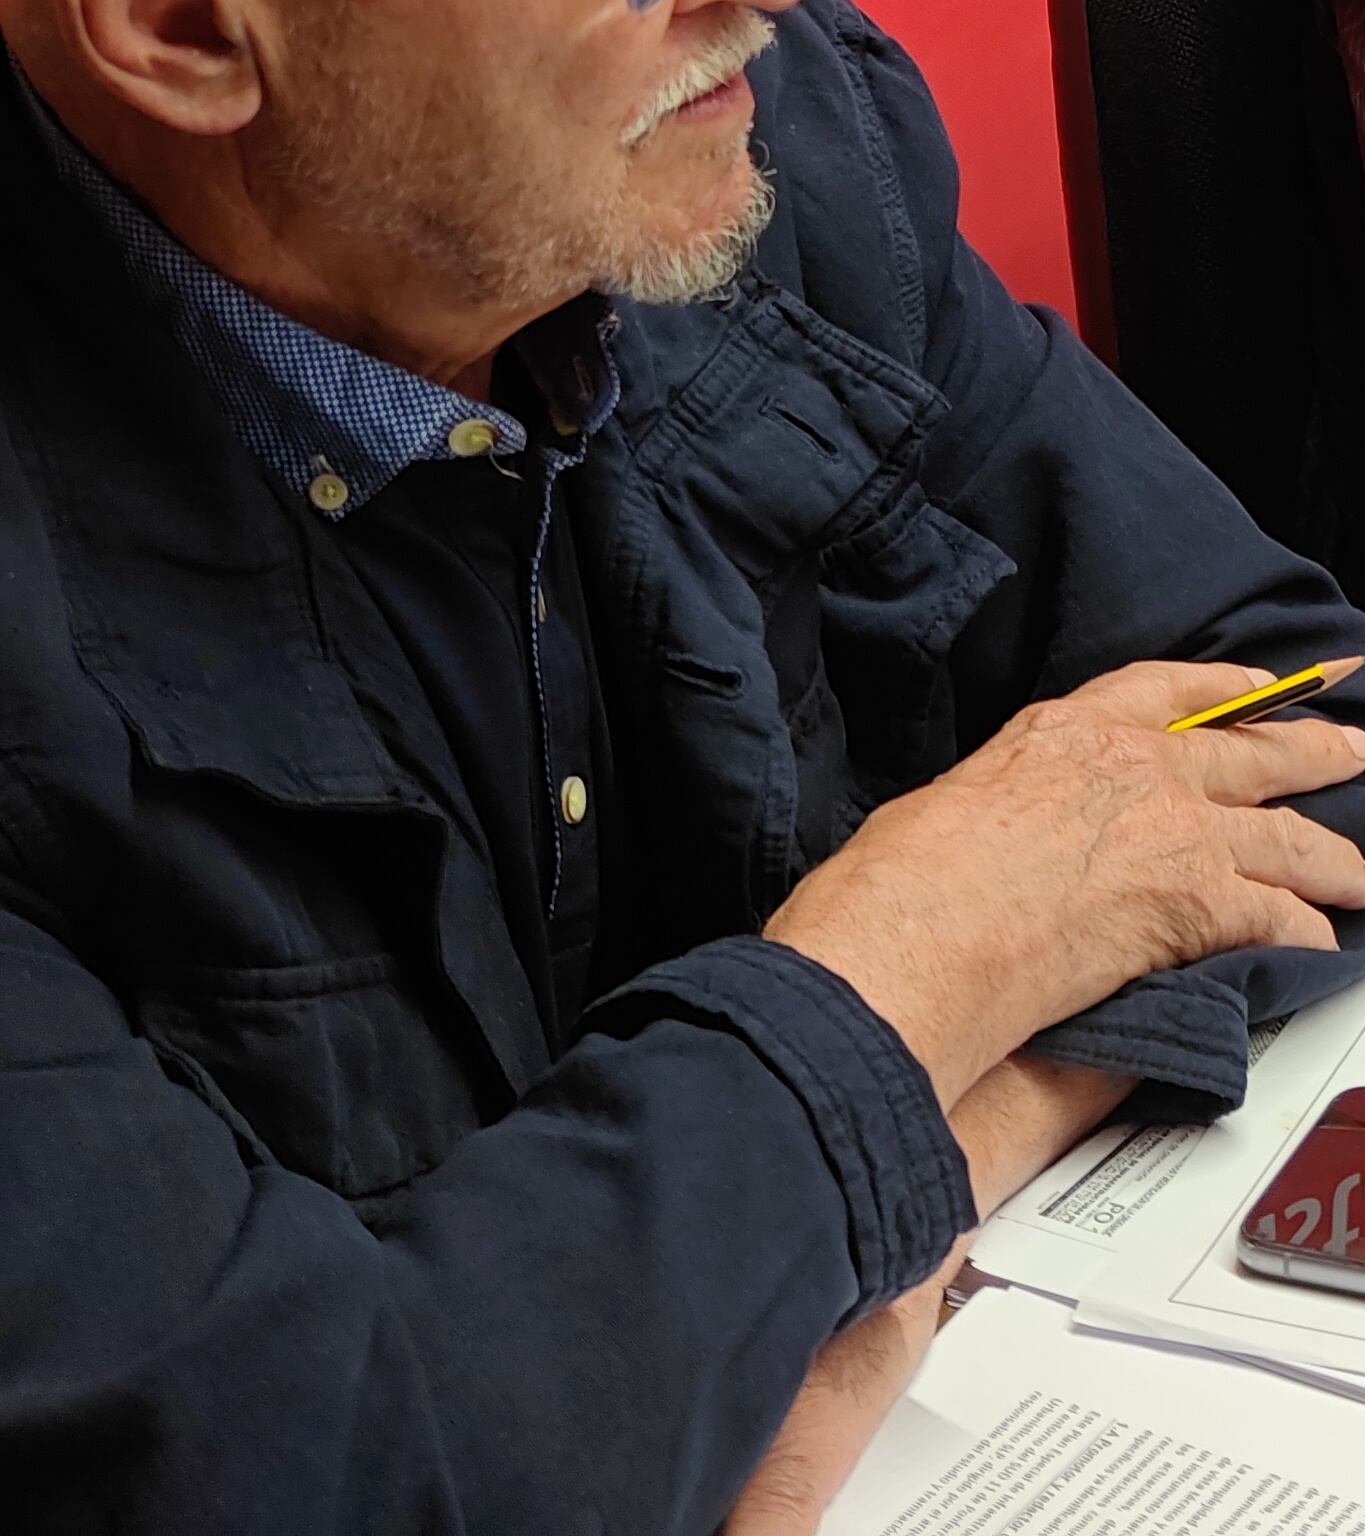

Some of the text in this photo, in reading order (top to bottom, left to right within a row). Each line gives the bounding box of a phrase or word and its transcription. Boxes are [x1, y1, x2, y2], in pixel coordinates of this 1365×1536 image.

[988, 1391, 1042, 1439] responsable
[1032, 1414, 1070, 1446] entorno
[1076, 1411, 1101, 1429] Este
[972, 1440, 991, 1454] del
[1056, 1429, 1082, 1448] Plan
[939, 1453, 975, 1484] estudio
[1017, 1447, 1035, 1462] del
[1022, 1449, 1062, 1483] Especial
[1056, 1438, 1112, 1482] Promotor
[1216, 1457, 1232, 1469] de
[1236, 1464, 1254, 1475] La
[956, 1462, 993, 1493] dirigido
[1009, 1482, 1025, 1493] de
[1096, 1437, 1173, 1508] recomendaciones
[1116, 1462, 1174, 1511] actuaciones,
[1145, 1463, 1202, 1513] instrumento
[1195, 1470, 1219, 1490] vista
[971, 1492, 987, 1504] de
[1007, 1490, 1055, 1533] redactor
[1163, 1491, 1200, 1521] técnico
[1186, 1476, 1240, 1527] complejidad
